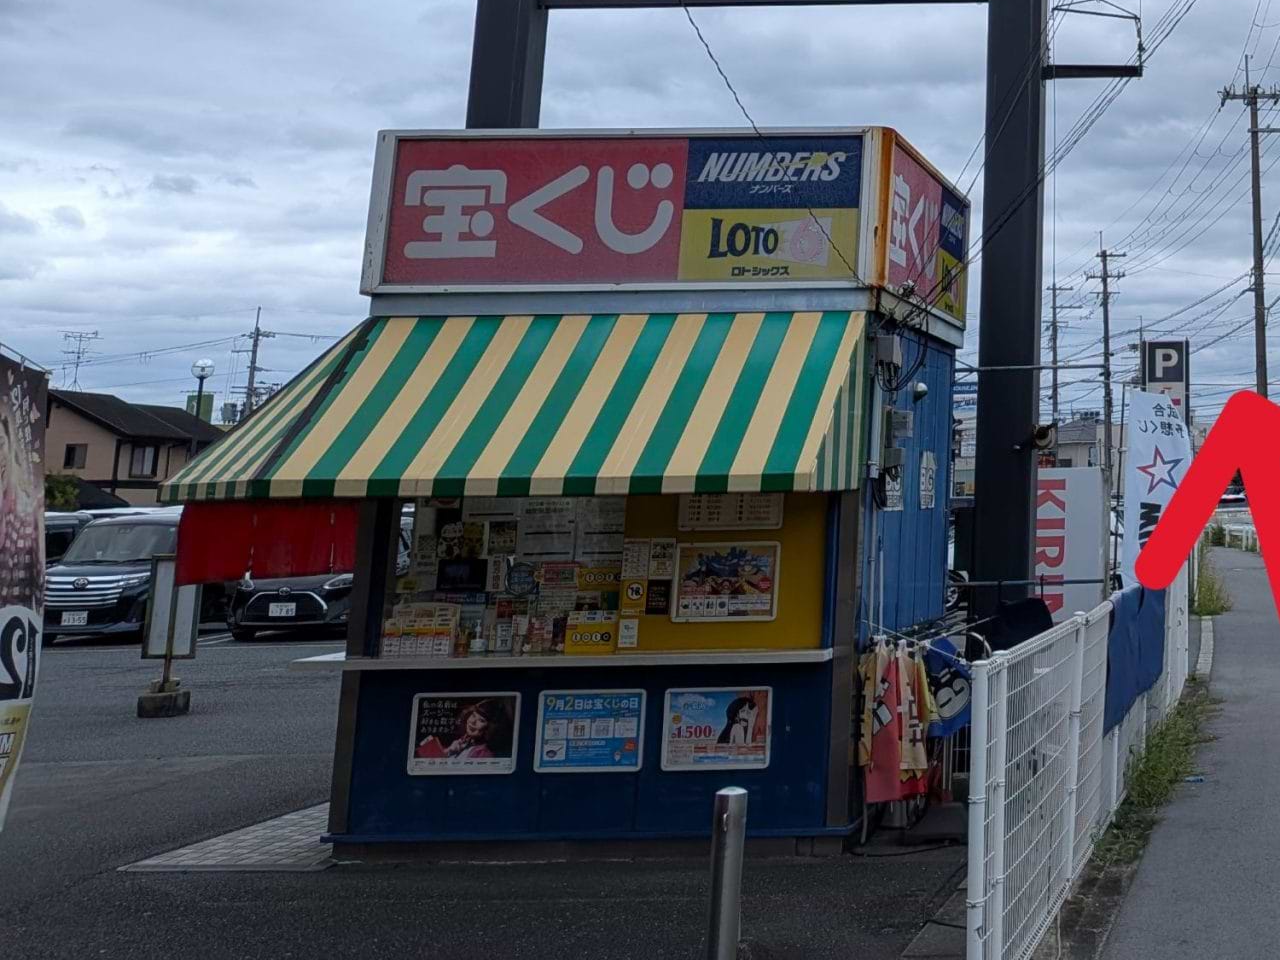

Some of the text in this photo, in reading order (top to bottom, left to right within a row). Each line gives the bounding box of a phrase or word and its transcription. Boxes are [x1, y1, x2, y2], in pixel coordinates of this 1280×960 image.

[697, 151, 847, 183] NUMBERS
[749, 184, 794, 195] ナンバーズ
[402, 162, 676, 260] 宝くじ
[707, 216, 779, 259] LOTO
[731, 266, 791, 277] ロトシックス
[1155, 348, 1179, 378] P
[572, 632, 611, 642] toto
[546, 696, 640, 711] 9月2日は宝くじの日
